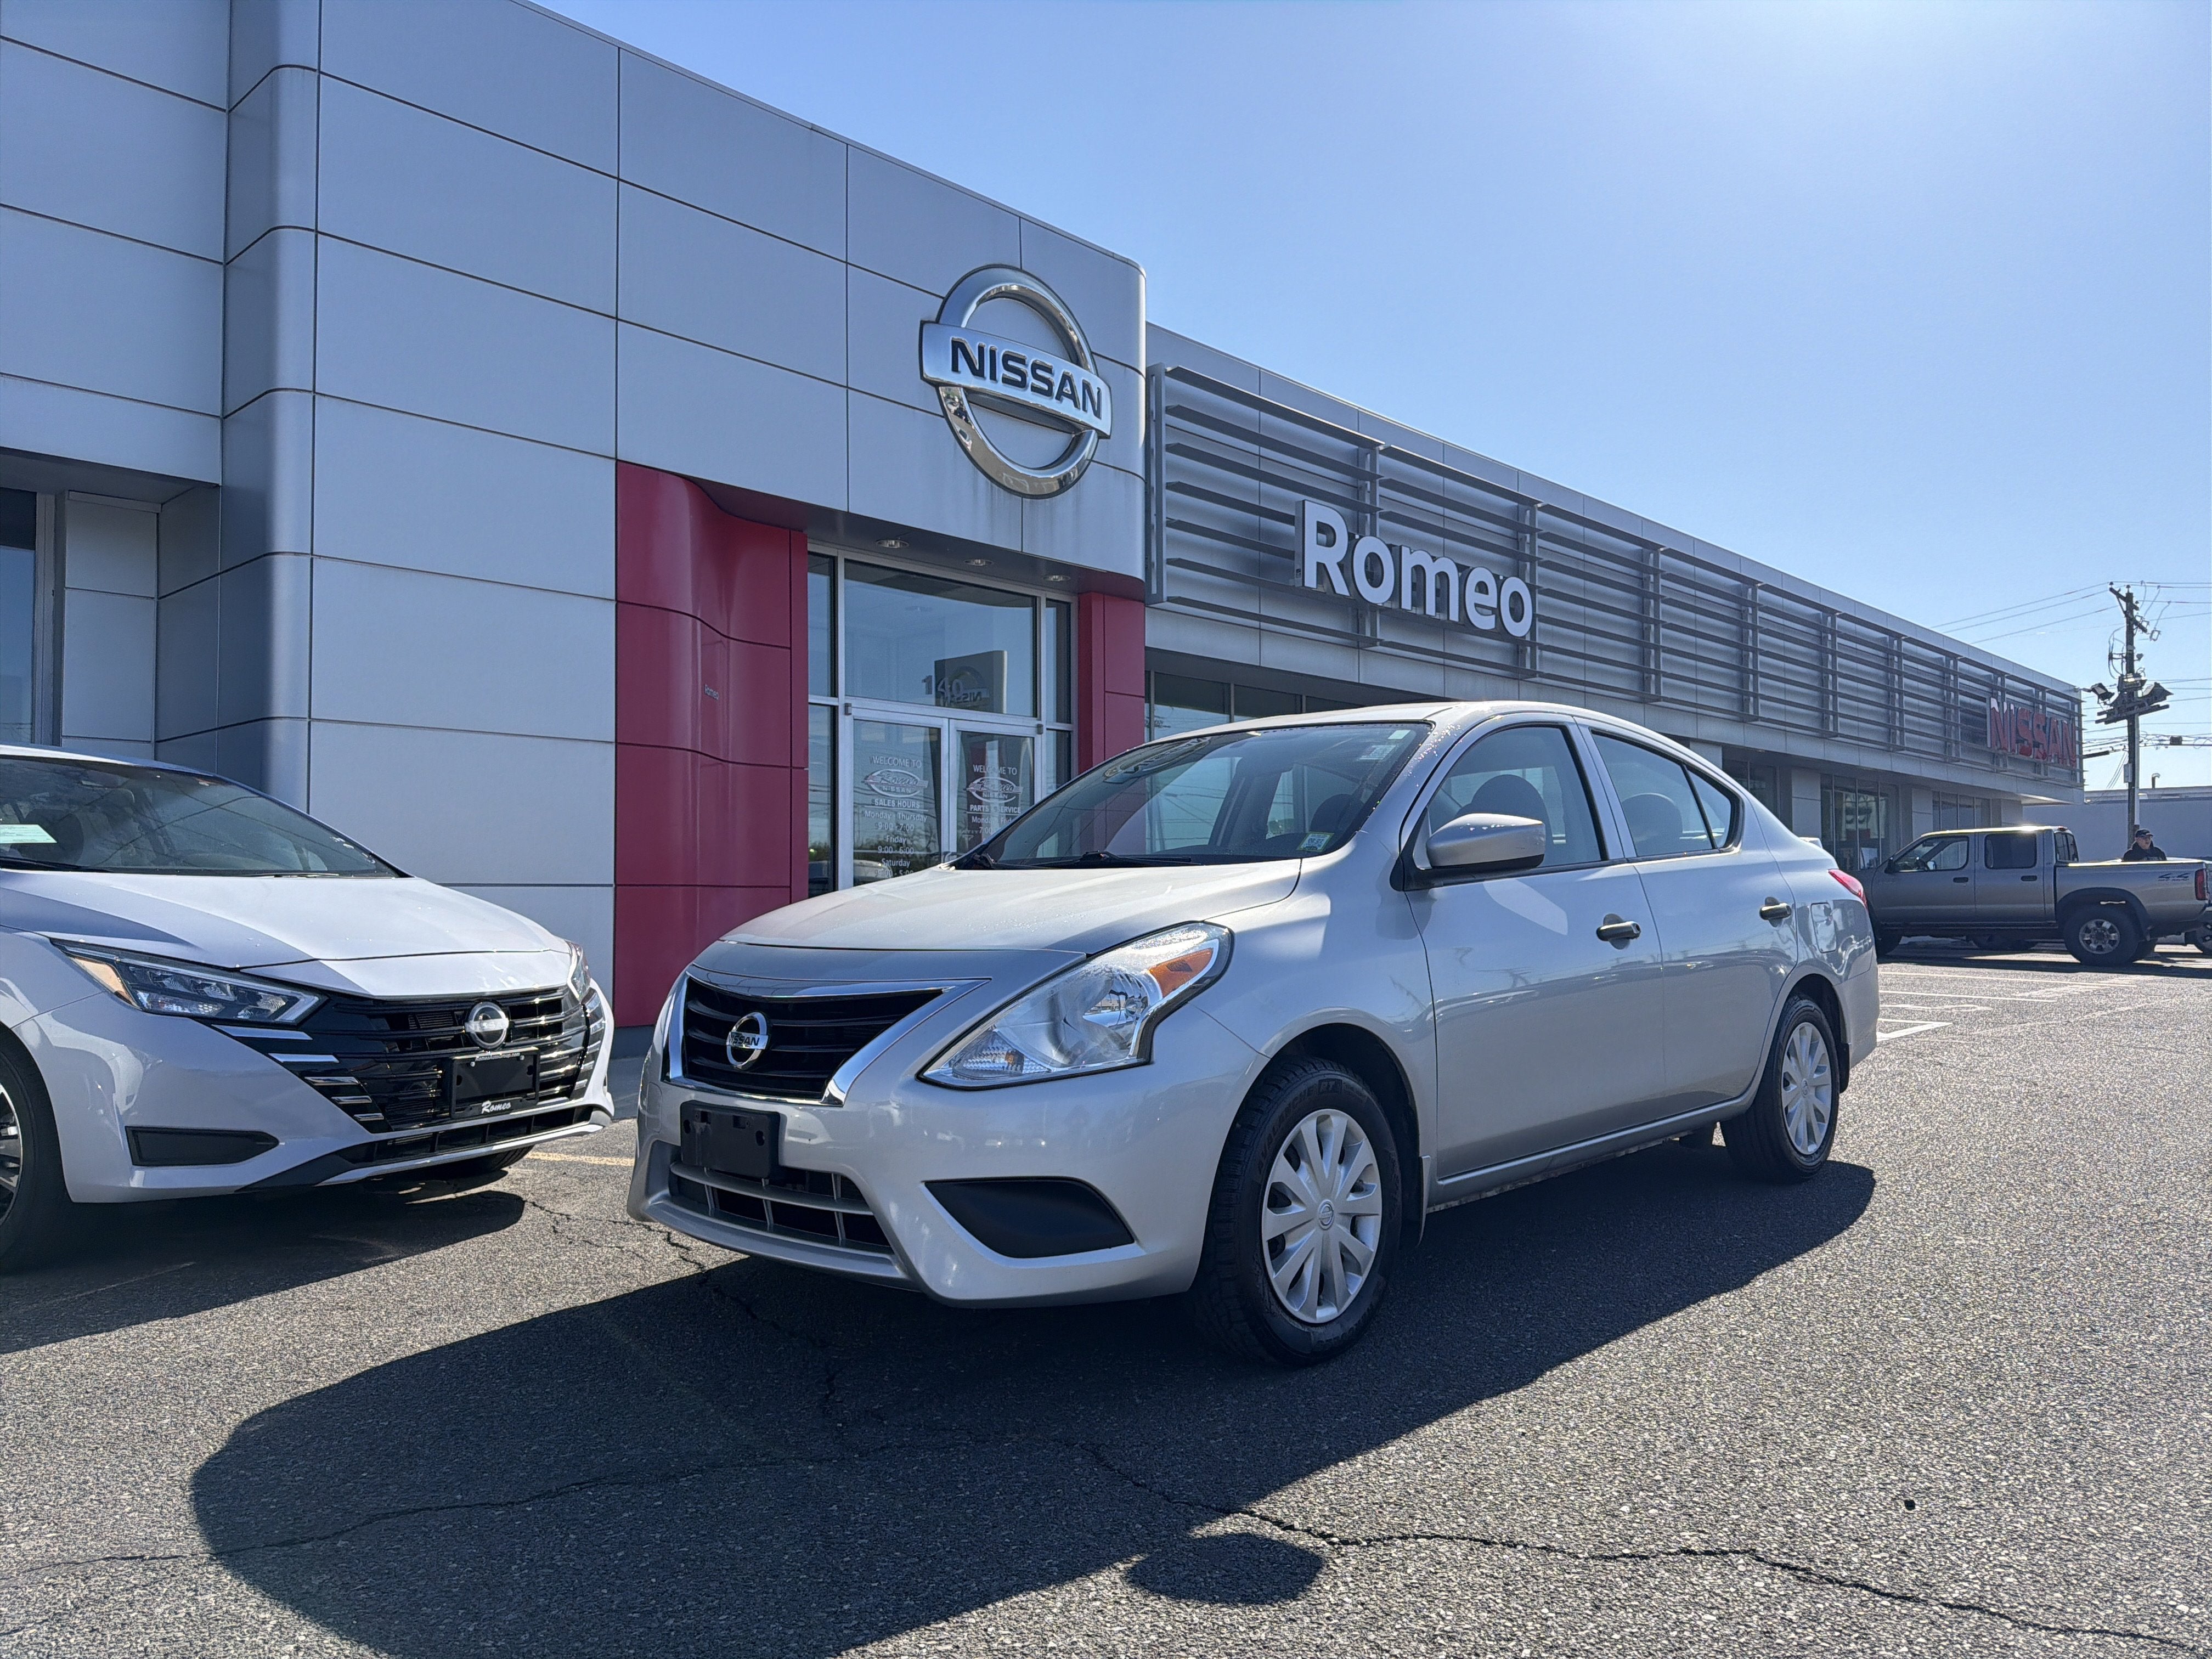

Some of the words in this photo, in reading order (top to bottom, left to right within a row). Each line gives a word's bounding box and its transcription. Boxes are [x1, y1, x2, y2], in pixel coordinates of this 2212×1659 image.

[951, 336, 1103, 420] NISSAN
[1300, 499, 1534, 638] Romeo
[922, 675, 963, 699] 140
[1990, 697, 2076, 768] NISSAN
[872, 755, 910, 767] WELCOME
[911, 759, 922, 768] TO
[1008, 767, 1017, 775] TO
[874, 798, 896, 806] SALES
[898, 800, 921, 809] HOURS
[865, 810, 891, 820] Monday
[897, 812, 928, 822] Thursday
[972, 816, 994, 824] Monda
[878, 822, 893, 831] 9:00
[886, 835, 906, 845] Friday
[878, 845, 893, 854] 9:00
[882, 857, 911, 868] Saturday
[729, 1035, 760, 1046] NISSAN
[481, 1100, 511, 1114] Romeo
